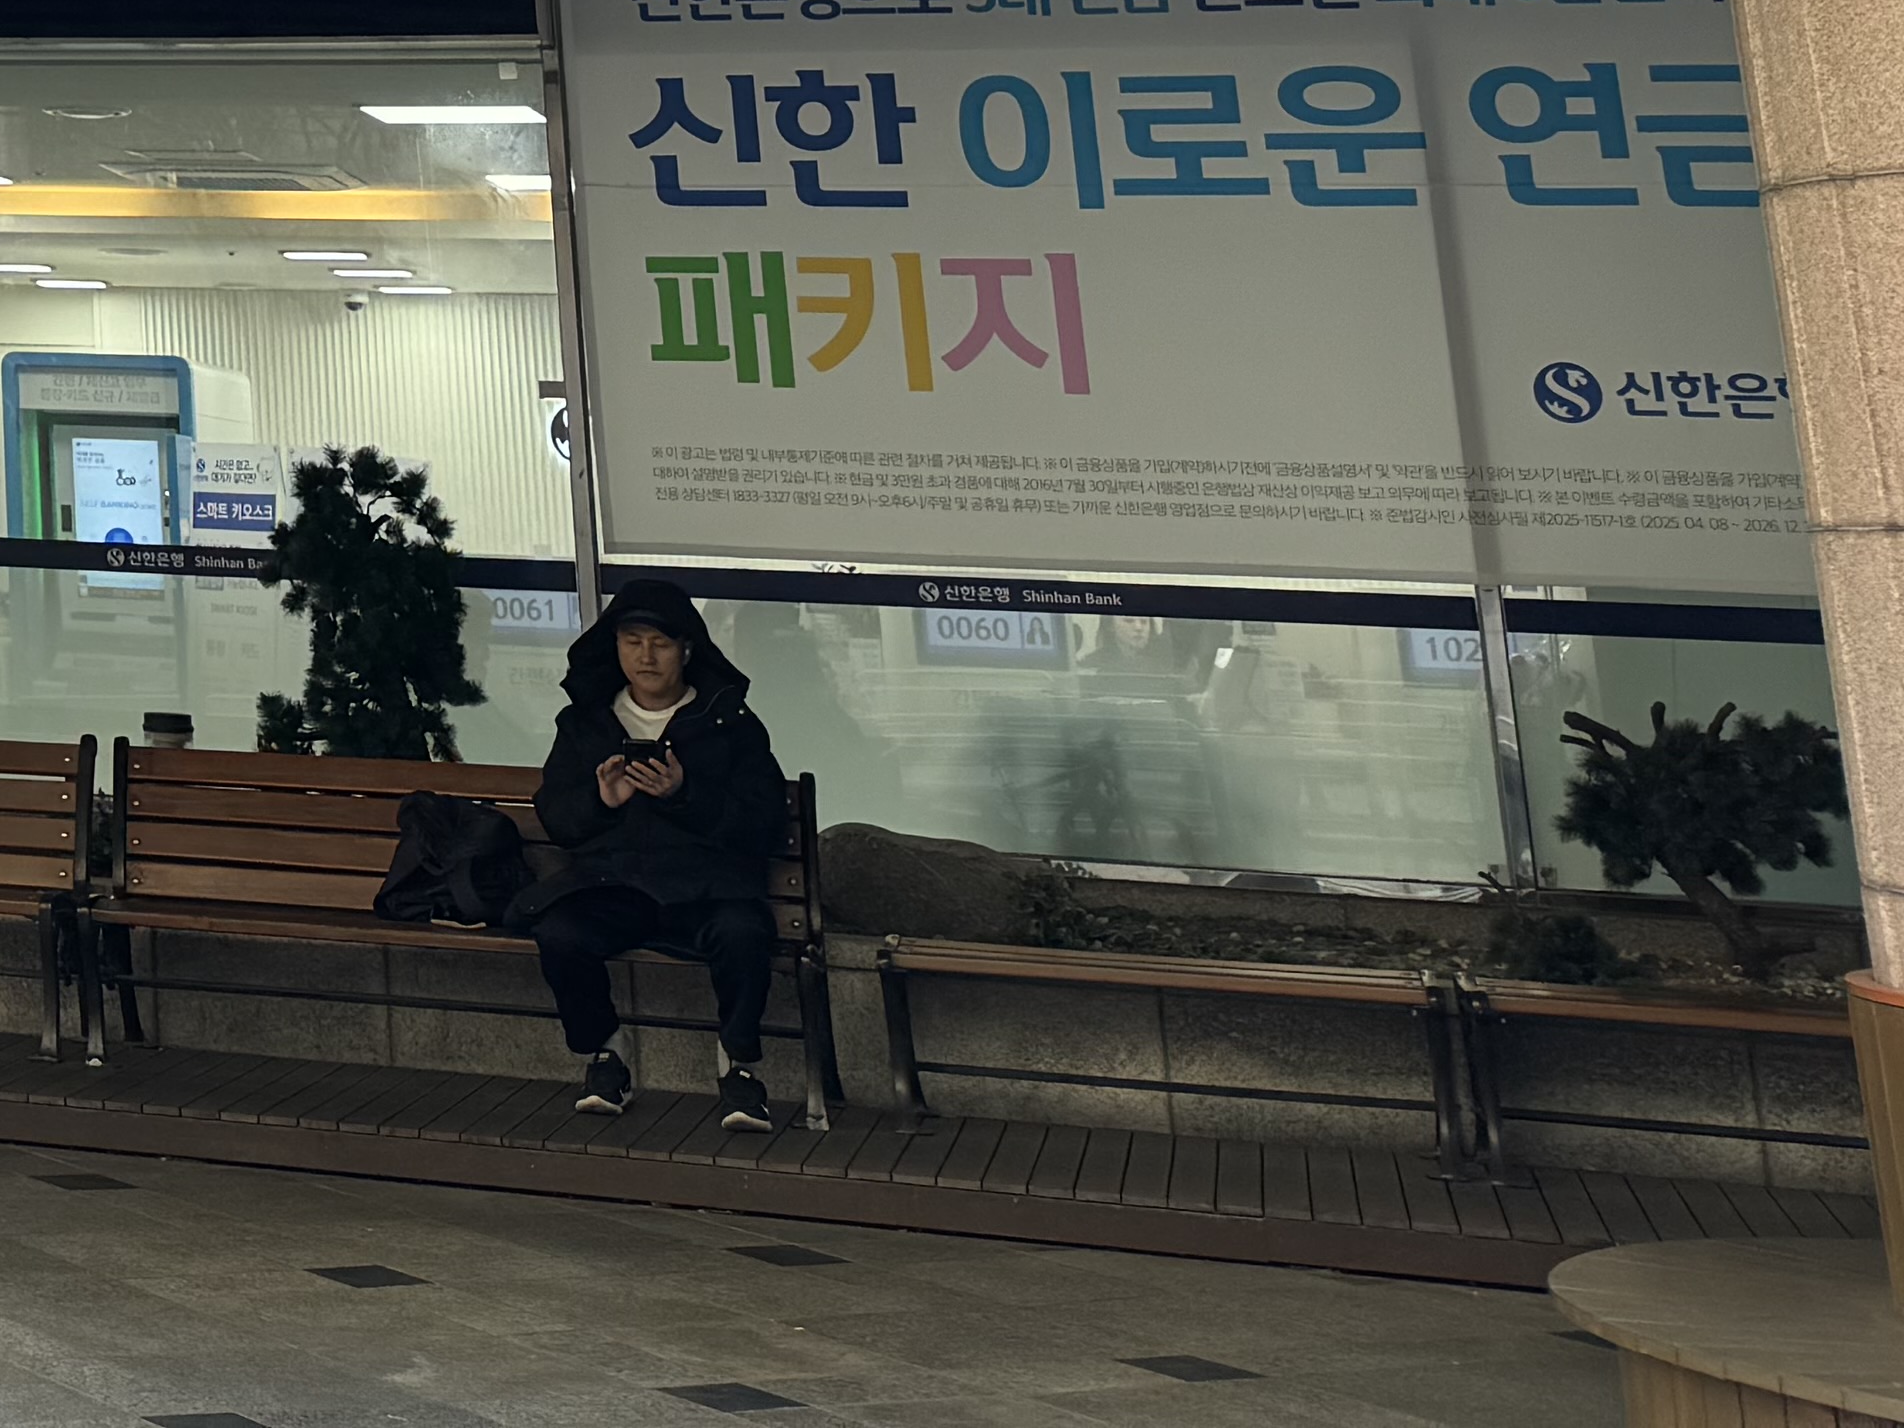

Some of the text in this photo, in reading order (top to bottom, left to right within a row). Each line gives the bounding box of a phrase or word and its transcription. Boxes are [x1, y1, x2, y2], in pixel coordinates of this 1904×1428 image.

[628, 61, 1762, 210] 신한 이로운 연금
[644, 250, 1093, 396] 패키지
[196, 502, 273, 521] 스마트 키오스크
[128, 550, 244, 569] 신한은행 Shinhan
[494, 596, 555, 623] 0061
[943, 584, 1123, 608] 신한은행 Shinhan Bank
[936, 613, 1011, 643] 0060
